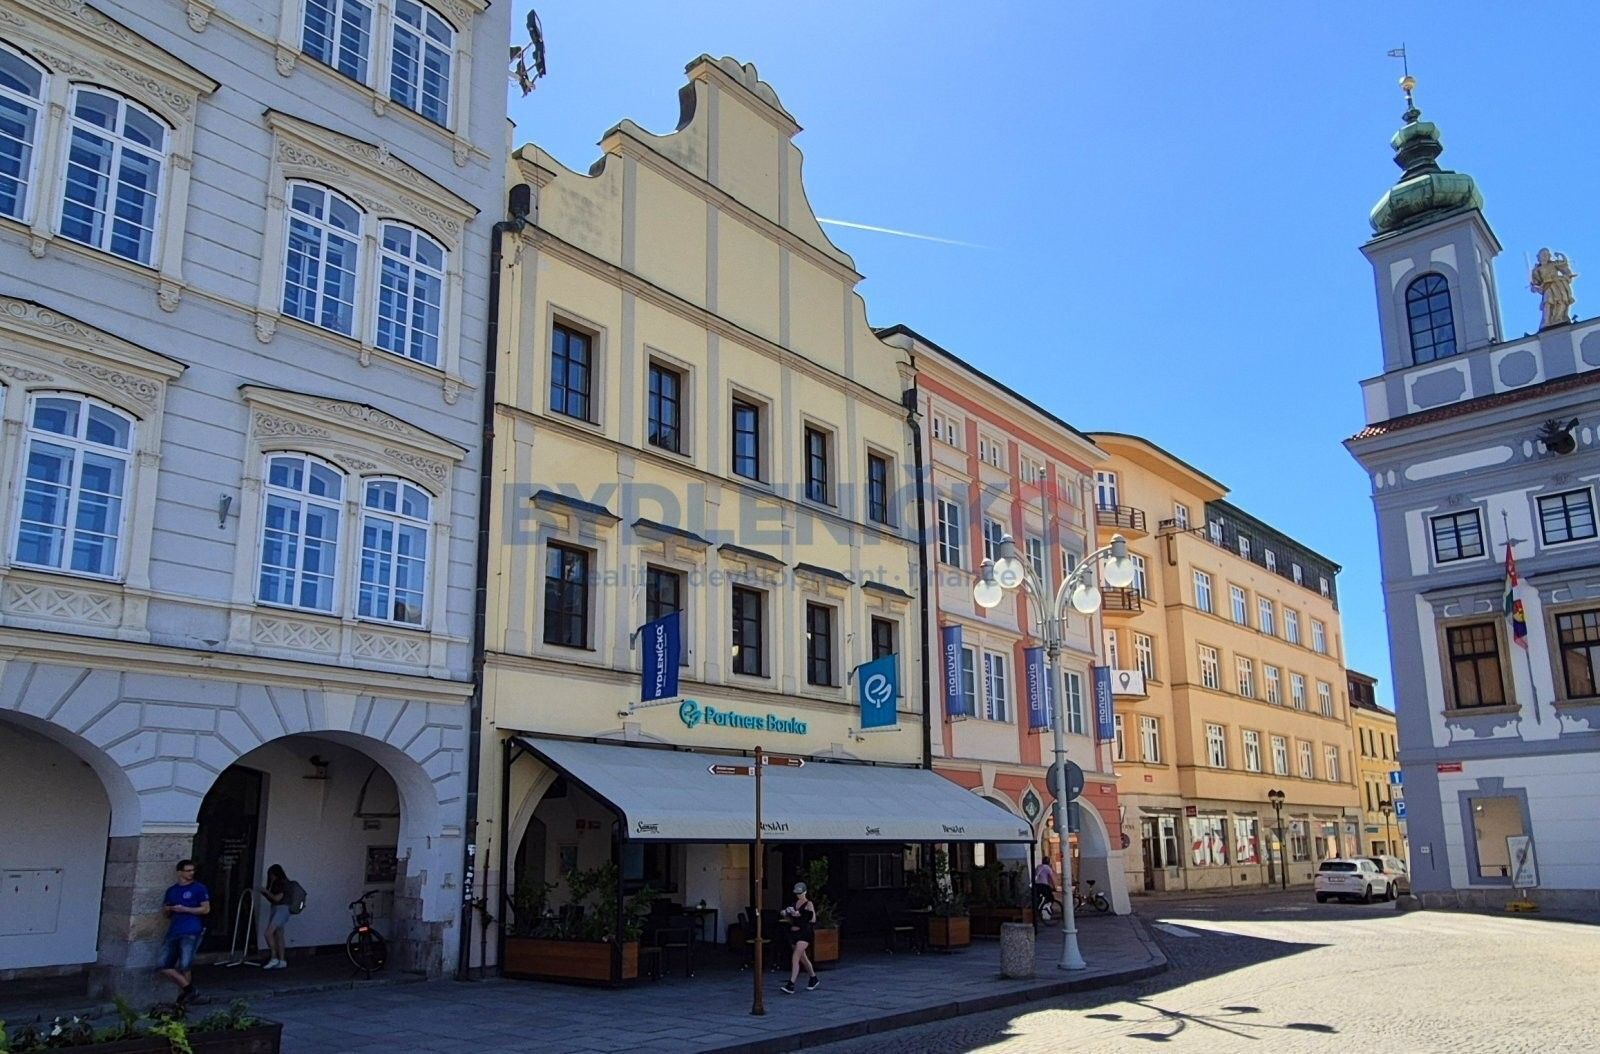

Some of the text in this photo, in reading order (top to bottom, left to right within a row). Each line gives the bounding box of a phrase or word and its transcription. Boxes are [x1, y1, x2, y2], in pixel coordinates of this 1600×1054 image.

[945, 644, 956, 696] manuvia
[1027, 663, 1038, 711] manuvia
[703, 706, 808, 735] Partners Banka
[1096, 681, 1106, 724] manuvia
[1396, 802, 1406, 814] P
